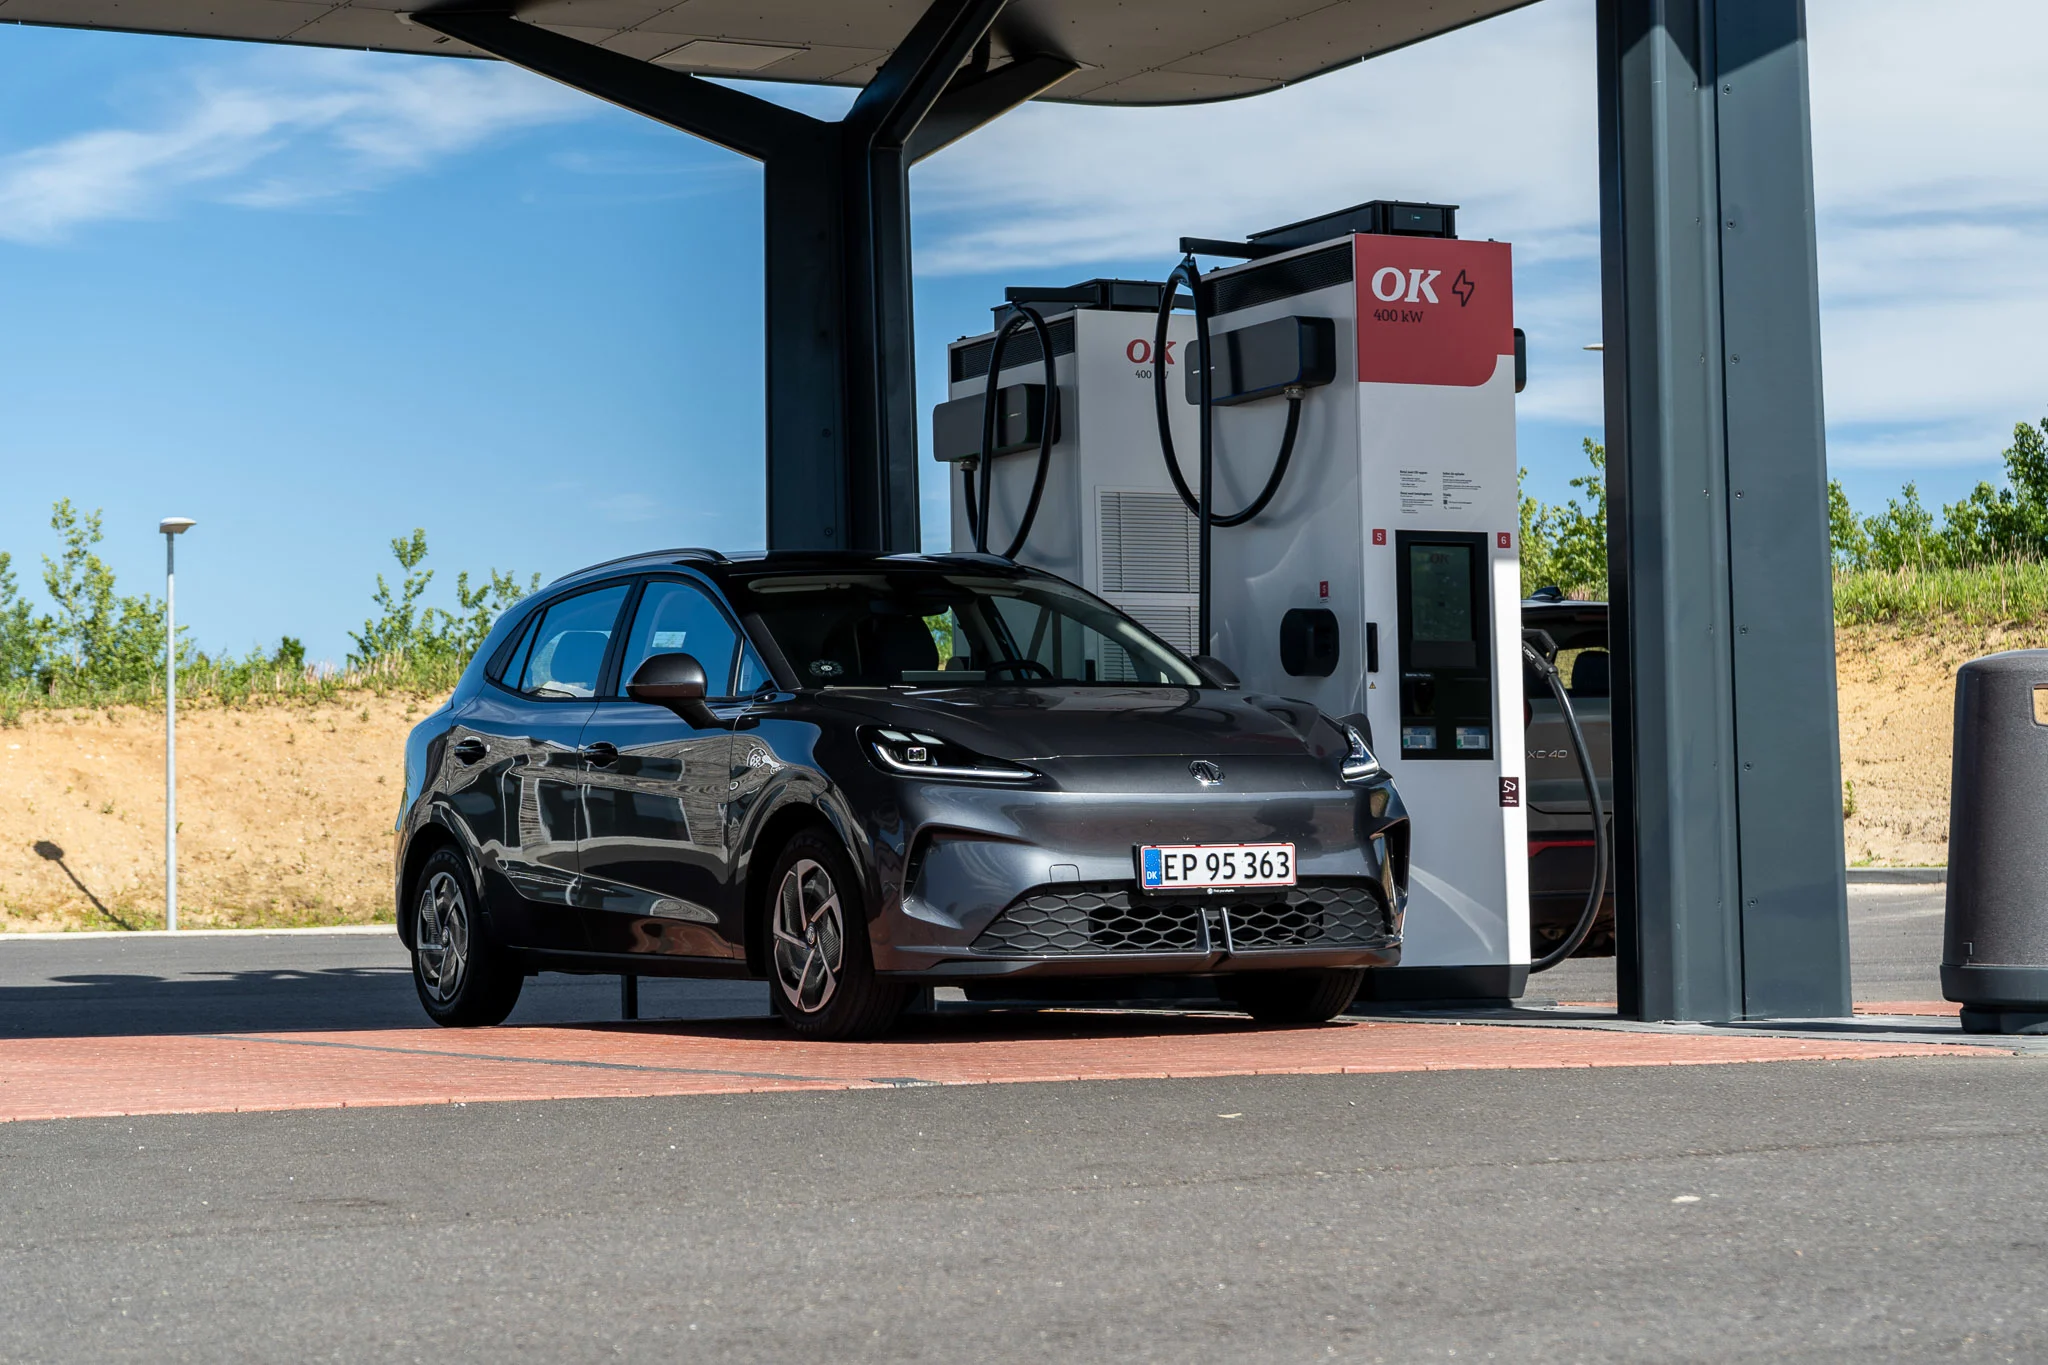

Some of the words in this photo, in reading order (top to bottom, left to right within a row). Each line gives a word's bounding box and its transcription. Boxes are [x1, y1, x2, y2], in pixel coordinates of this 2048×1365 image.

[1371, 266, 1442, 304] OK
[1373, 308, 1398, 322] 400
[1401, 310, 1424, 323] kW
[1135, 369, 1152, 379] 400
[1376, 533, 1382, 541] 5
[1501, 536, 1507, 545] 6
[1164, 854, 1198, 881] EP
[1206, 852, 1236, 881] 95
[1243, 850, 1290, 879] 363
[1146, 871, 1158, 880] DK
